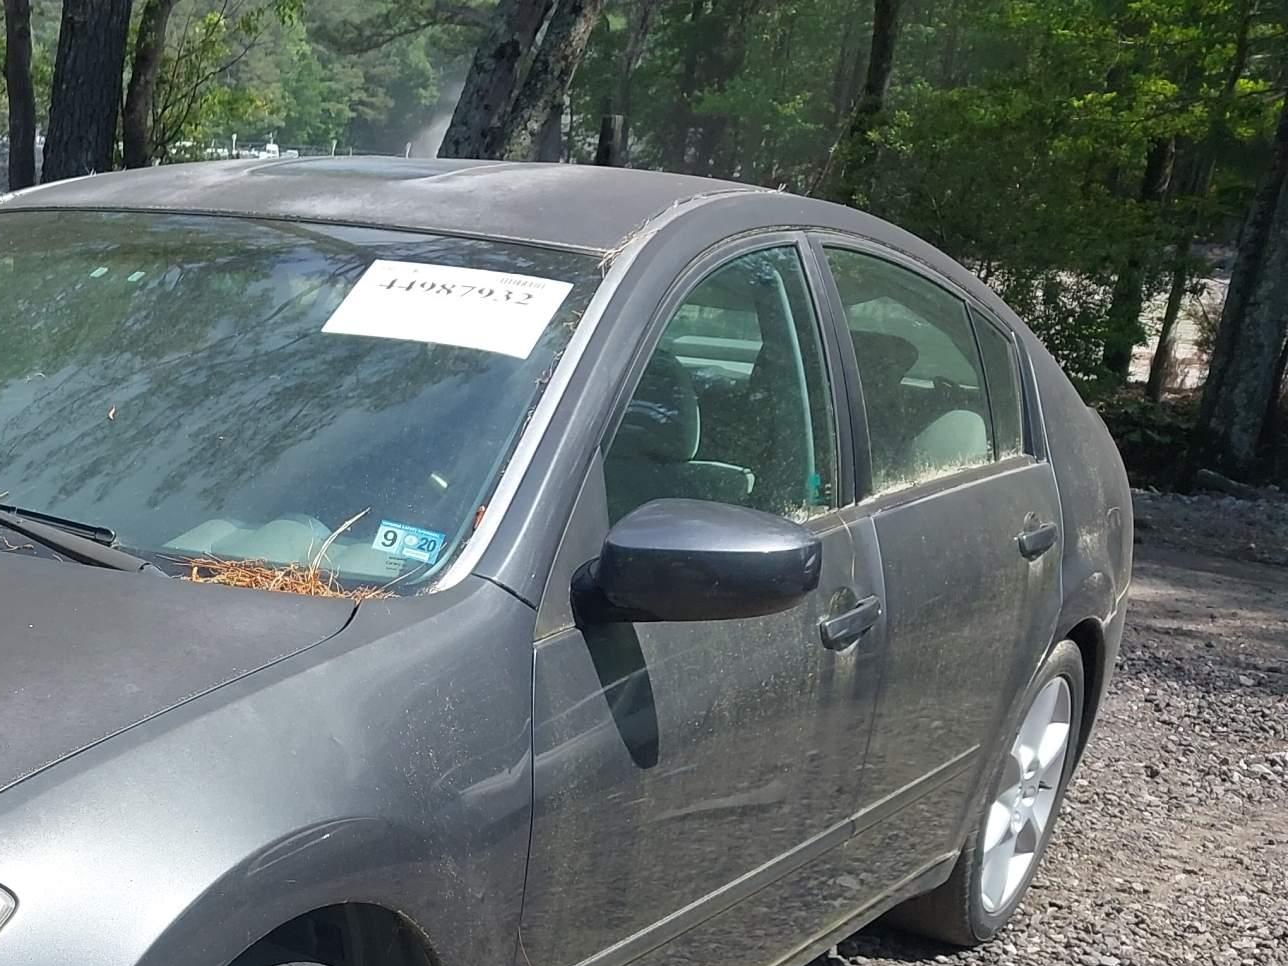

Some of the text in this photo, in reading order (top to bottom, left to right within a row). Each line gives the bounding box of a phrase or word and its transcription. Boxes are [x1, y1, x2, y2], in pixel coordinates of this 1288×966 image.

[378, 278, 535, 305] 44987932
[381, 530, 436, 552] 9 20
